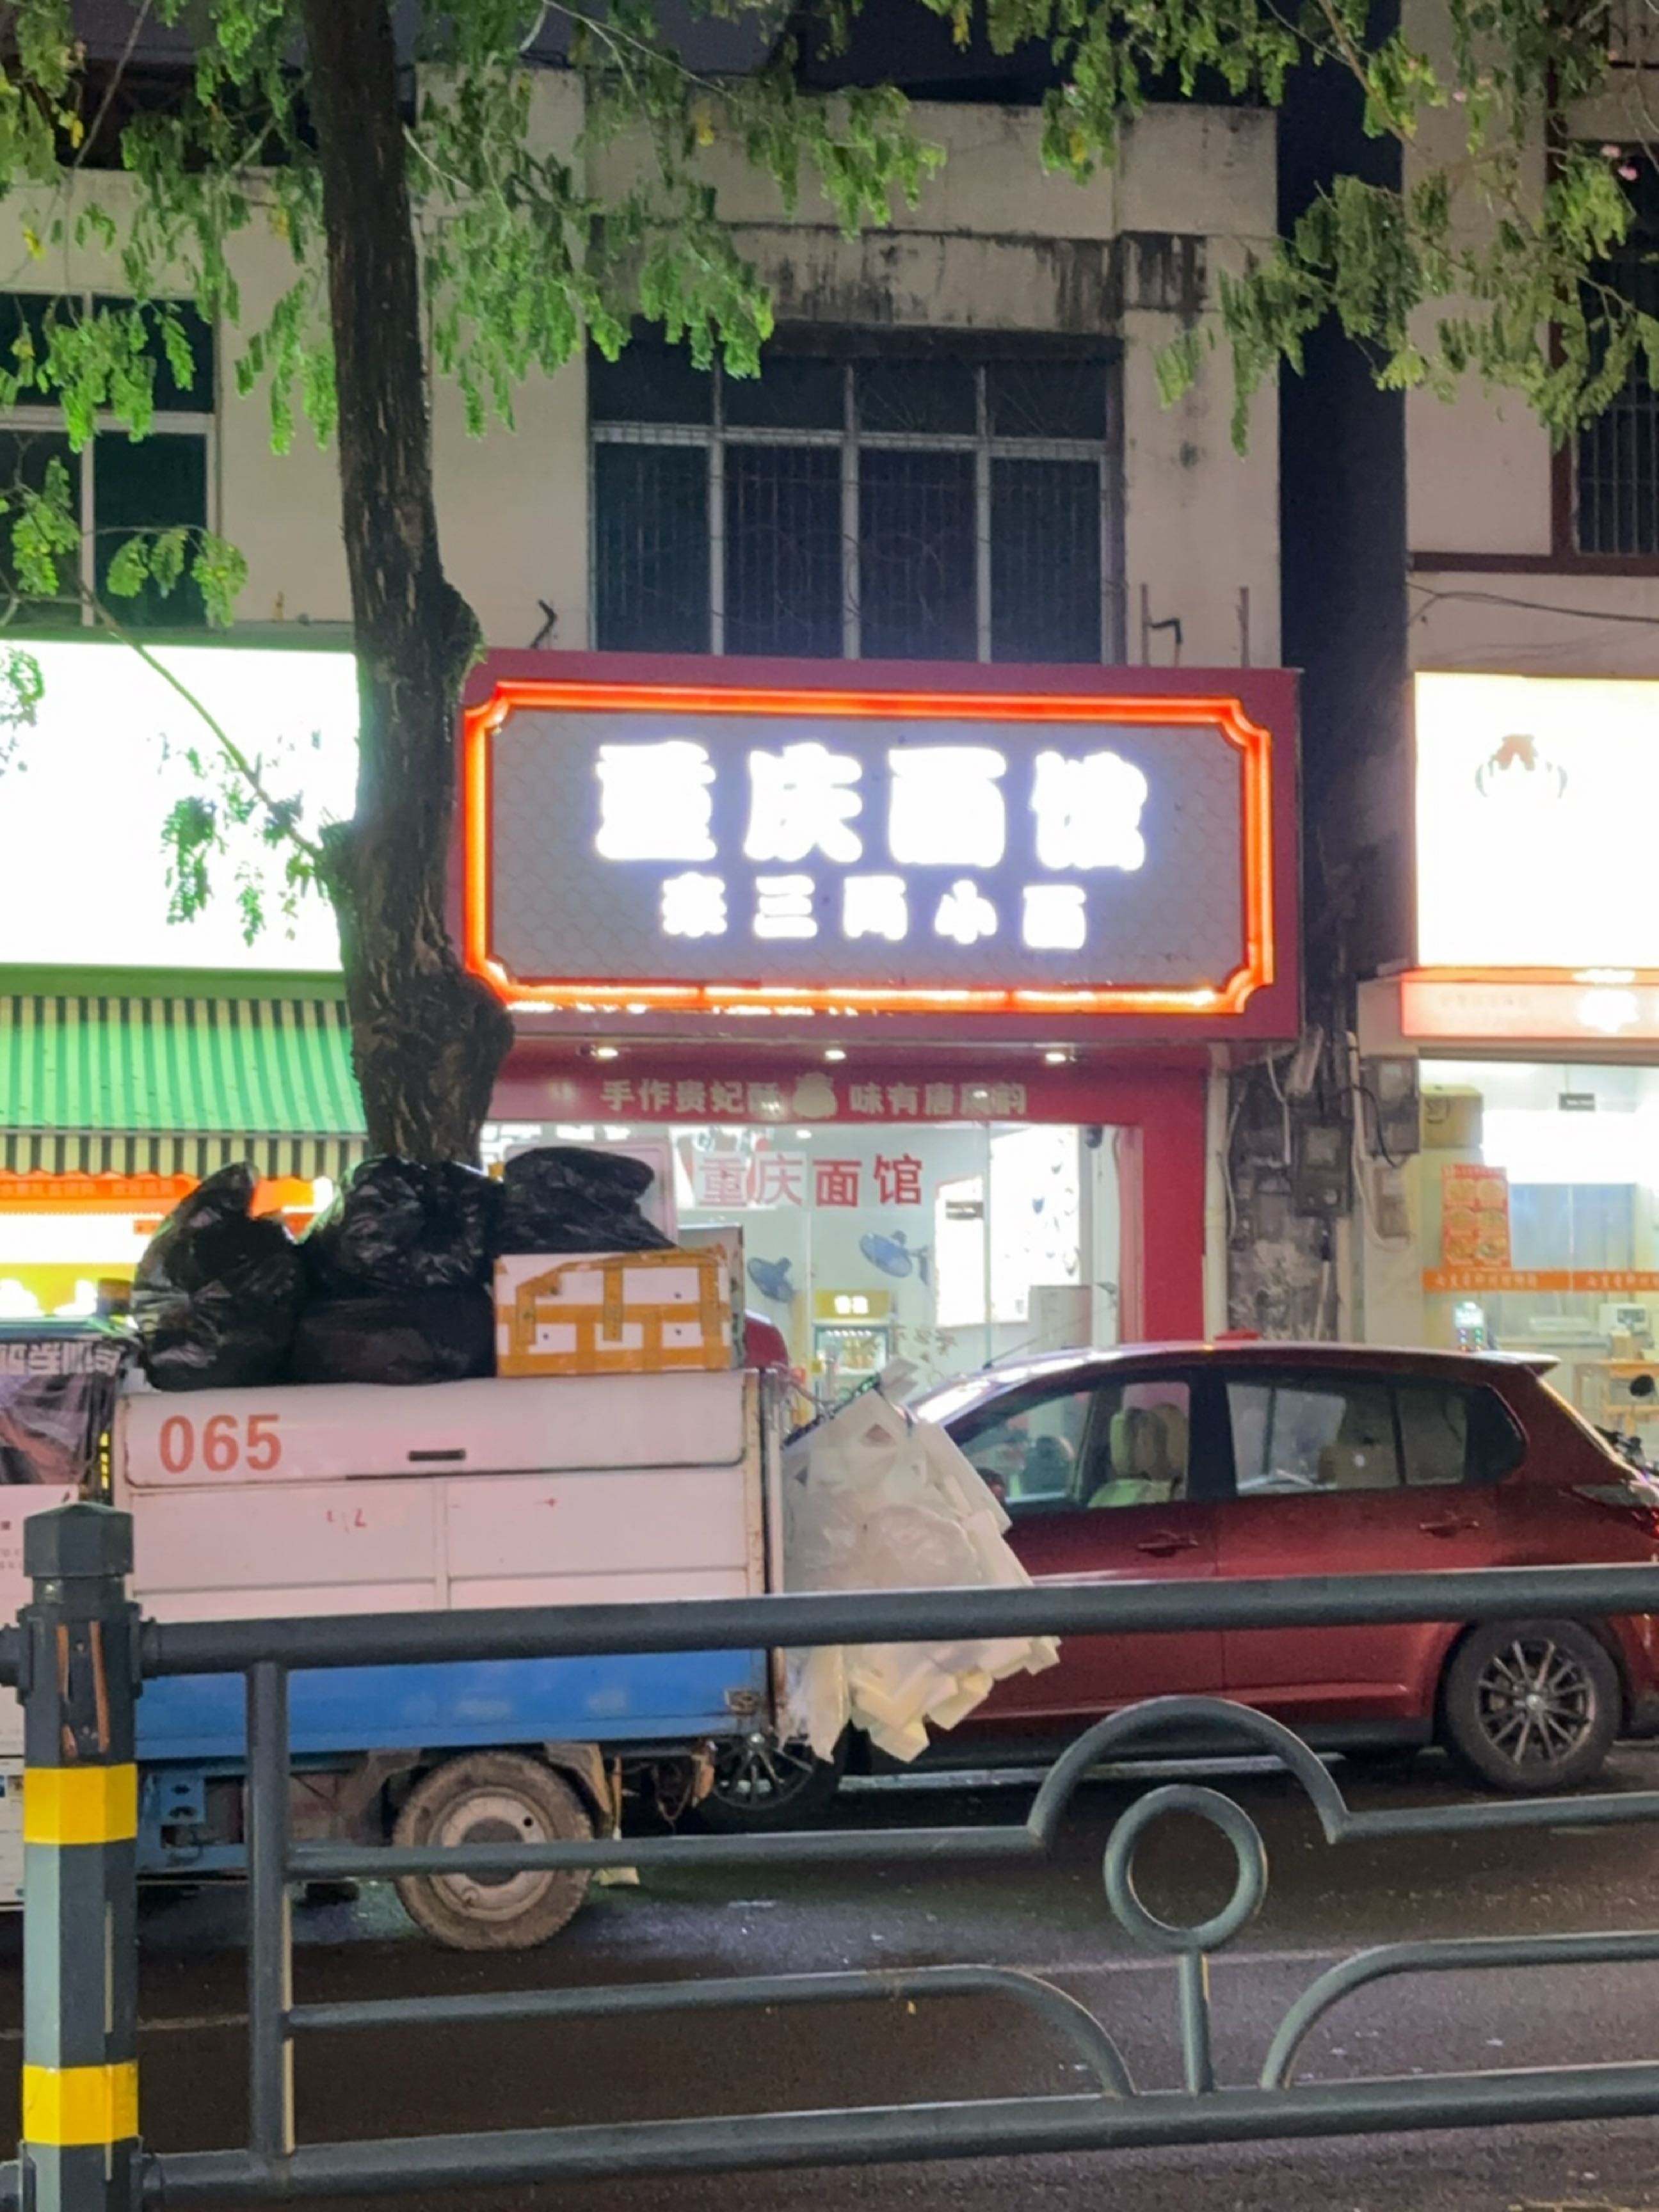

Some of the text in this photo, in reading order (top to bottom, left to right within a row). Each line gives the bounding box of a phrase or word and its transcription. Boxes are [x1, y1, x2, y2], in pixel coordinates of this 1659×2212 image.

[595, 741, 1148, 870] 重庆面馆
[699, 1153, 922, 1208] 重庆面馆
[159, 1414, 282, 1473] 065
